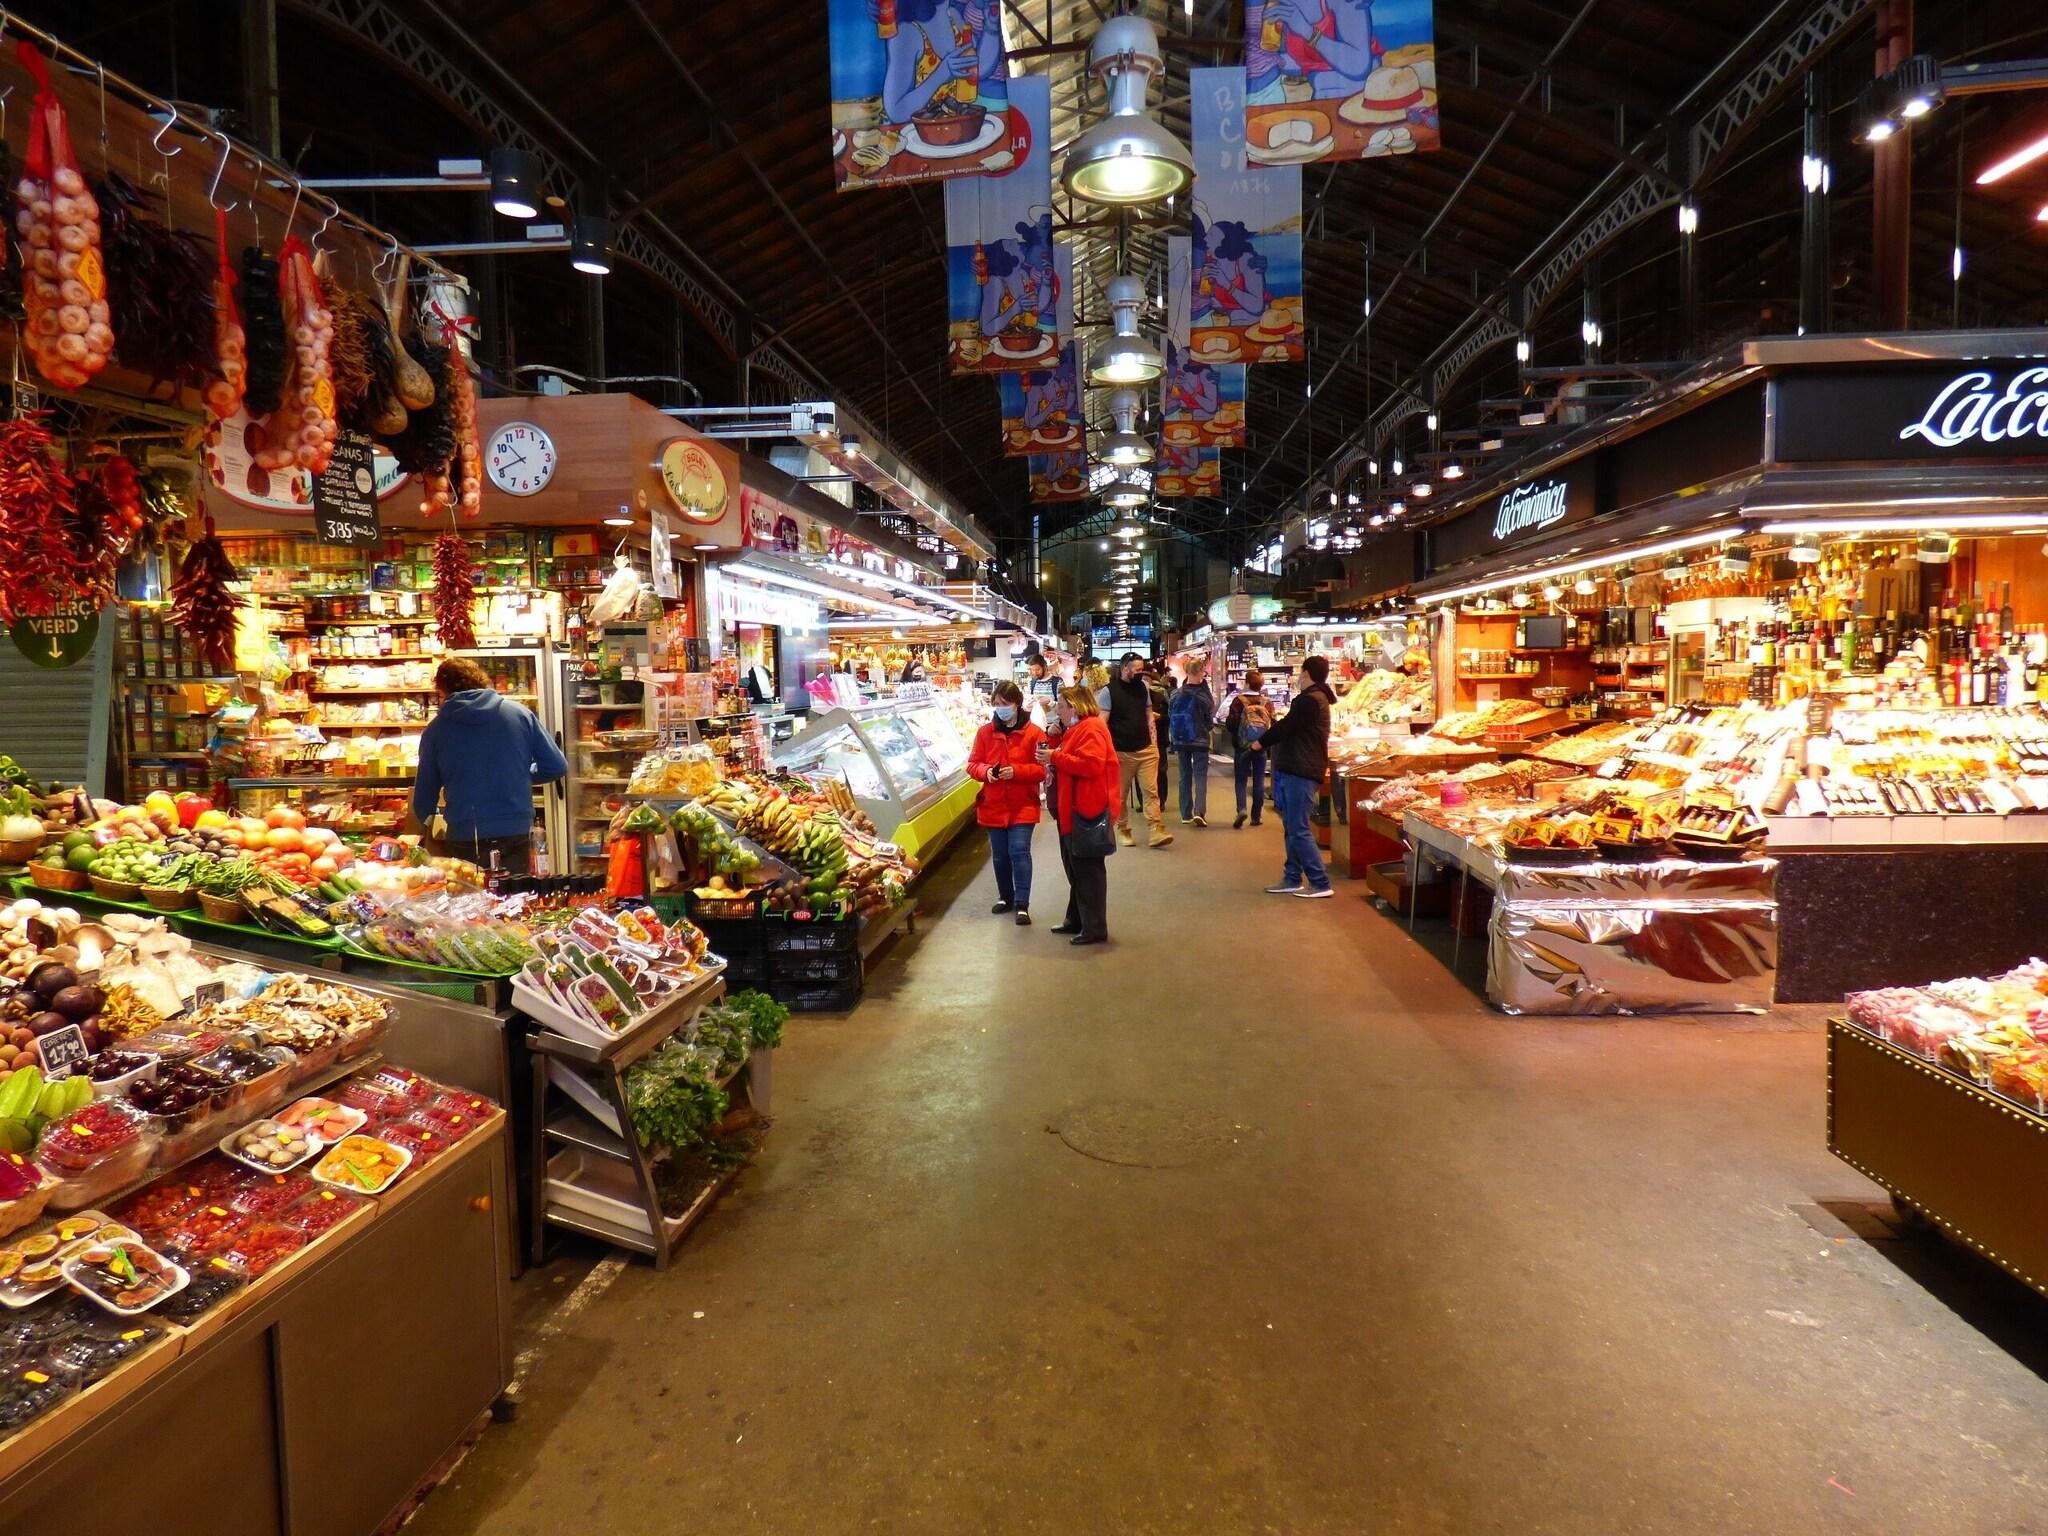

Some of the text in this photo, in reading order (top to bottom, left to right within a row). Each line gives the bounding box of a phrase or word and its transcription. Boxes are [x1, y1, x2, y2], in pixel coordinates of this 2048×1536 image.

[504, 433, 513, 443] 11
[514, 429, 526, 440] 12
[529, 431, 535, 442] 1
[496, 443, 507, 454] 10
[539, 440, 546, 450] 2
[493, 456, 500, 467] 9
[544, 453, 551, 463] 3
[499, 469, 506, 479] 8
[541, 466, 548, 475] 4
[510, 477, 517, 487] 7
[522, 480, 529, 490] 6
[533, 476, 541, 486] 5
[28, 618, 79, 634] VERD
